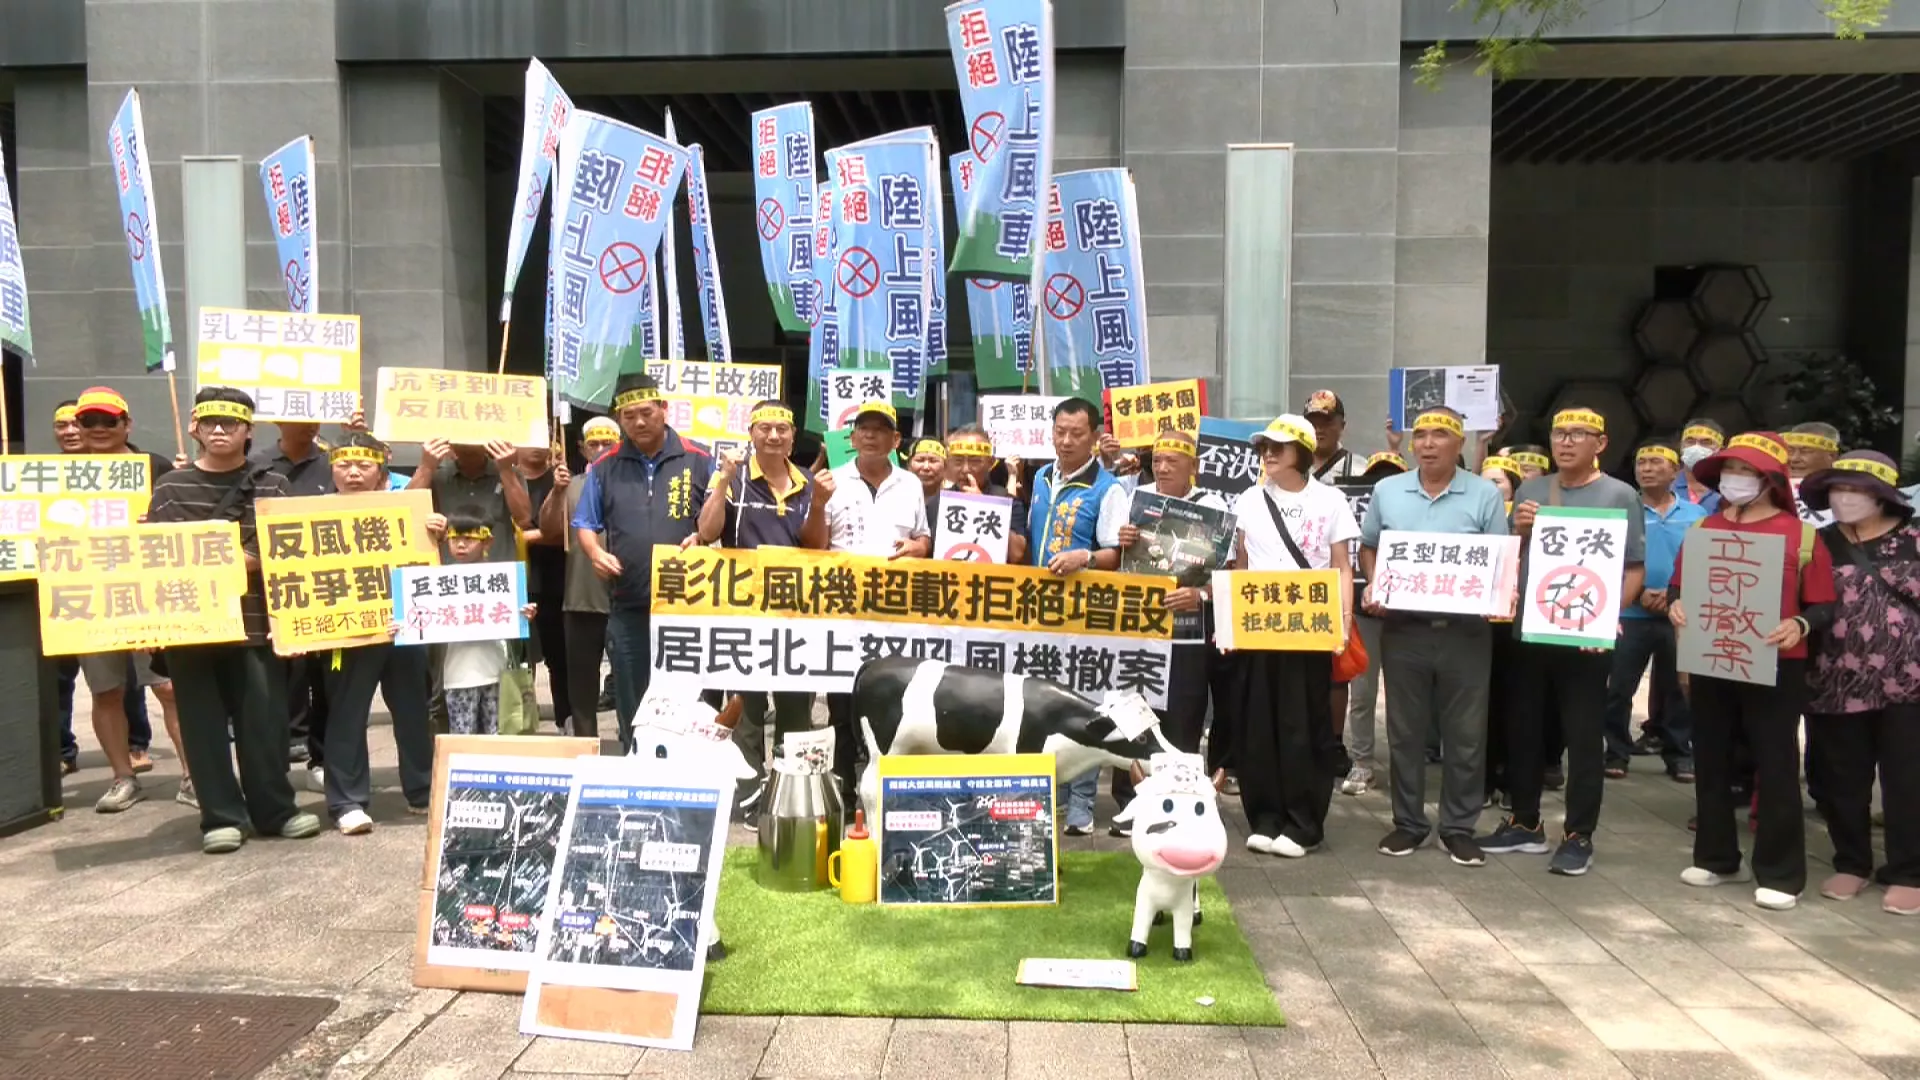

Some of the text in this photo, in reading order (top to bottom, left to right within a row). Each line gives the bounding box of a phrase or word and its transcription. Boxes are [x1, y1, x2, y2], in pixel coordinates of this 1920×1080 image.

[959, 10, 1000, 88] 拒絕
[758, 117, 777, 177] 拒絕
[999, 24, 1041, 264] 陸上風車
[837, 156, 869, 223] 拒絕
[783, 134, 812, 324] 陸上風車
[880, 176, 924, 398] 陸上風車
[1075, 202, 1134, 388] 陸上風車
[202, 314, 356, 349] 乳牛故鄉
[389, 371, 535, 398] 抗爭到底
[648, 363, 779, 400] 乳牛故鄉
[835, 375, 886, 400] 否決
[1116, 388, 1196, 416] 守護家園
[1198, 442, 1262, 481] 否決
[945, 505, 1003, 541] 否決
[35, 531, 236, 573] 抗爭到底
[1387, 541, 1490, 567] 巨型風機
[1539, 526, 1617, 559] 否決
[268, 561, 431, 611] 抗爭到
[411, 572, 511, 598] 巨型風機
[657, 556, 1169, 635] 彰化風機超載拒絕增設
[1240, 580, 1329, 606] 守護家園
[1403, 571, 1485, 598] 滾出去
[435, 602, 513, 627] 滾出去
[1240, 611, 1334, 635] 拒絕風機
[1699, 533, 1766, 680] 立即撤案
[655, 626, 1168, 698] 居民北上怒吼風機撤案
